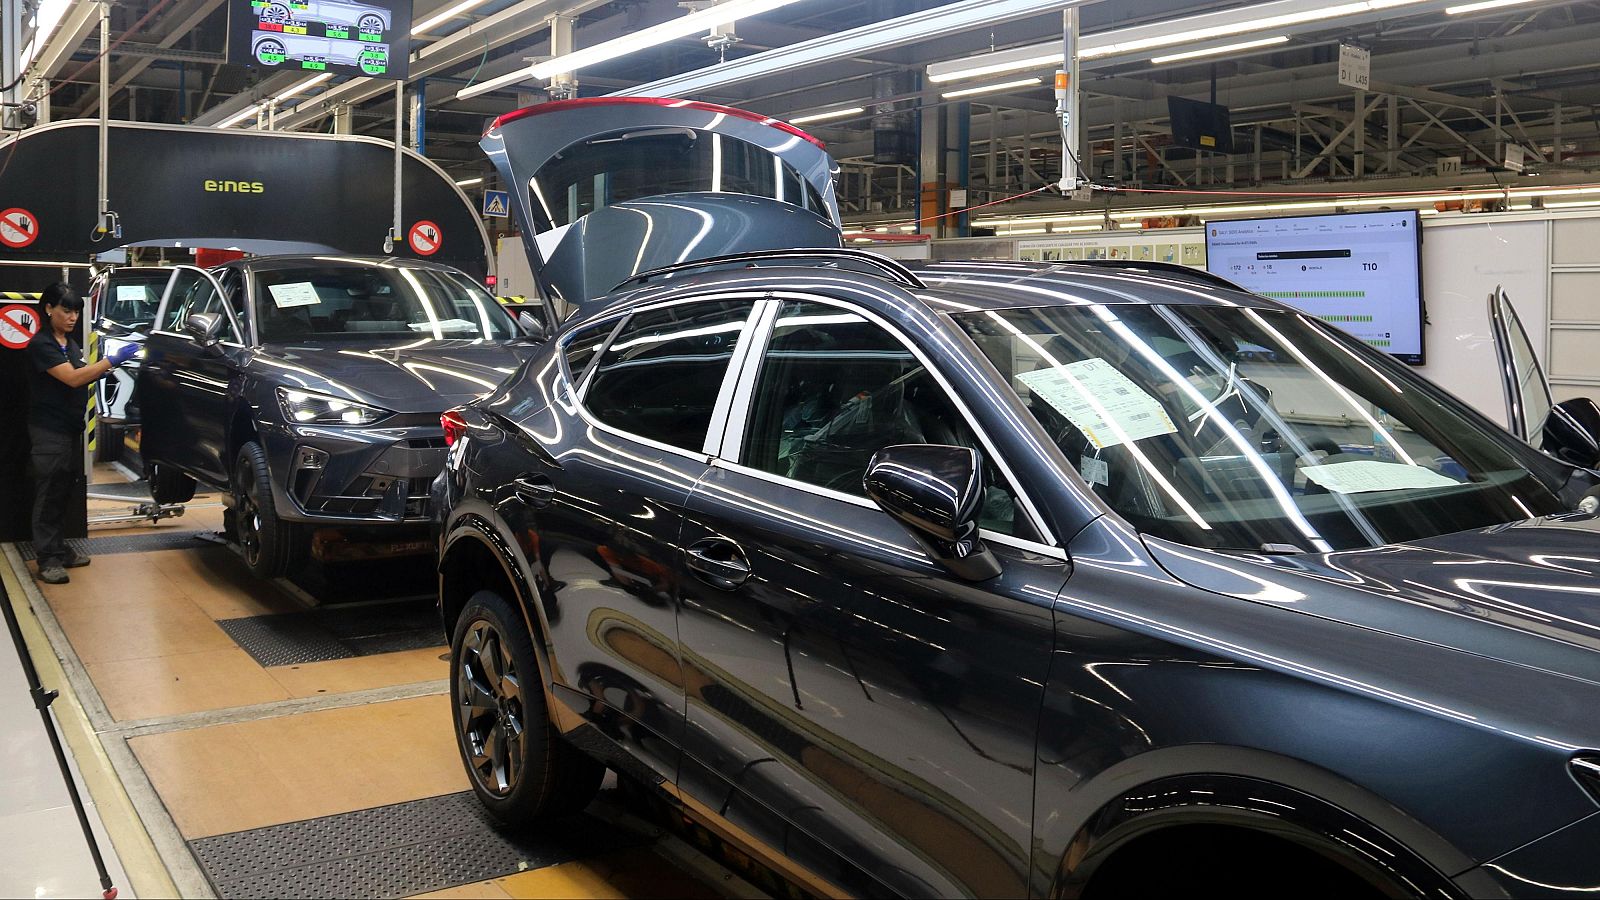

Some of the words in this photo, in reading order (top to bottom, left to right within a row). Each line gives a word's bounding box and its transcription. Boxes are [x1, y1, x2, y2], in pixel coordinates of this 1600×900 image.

[1355, 74, 1368, 85] L435
[1442, 162, 1457, 171] 171
[204, 180, 264, 193] eines
[1362, 263, 1377, 271] T10
[1083, 362, 1099, 371] DT
